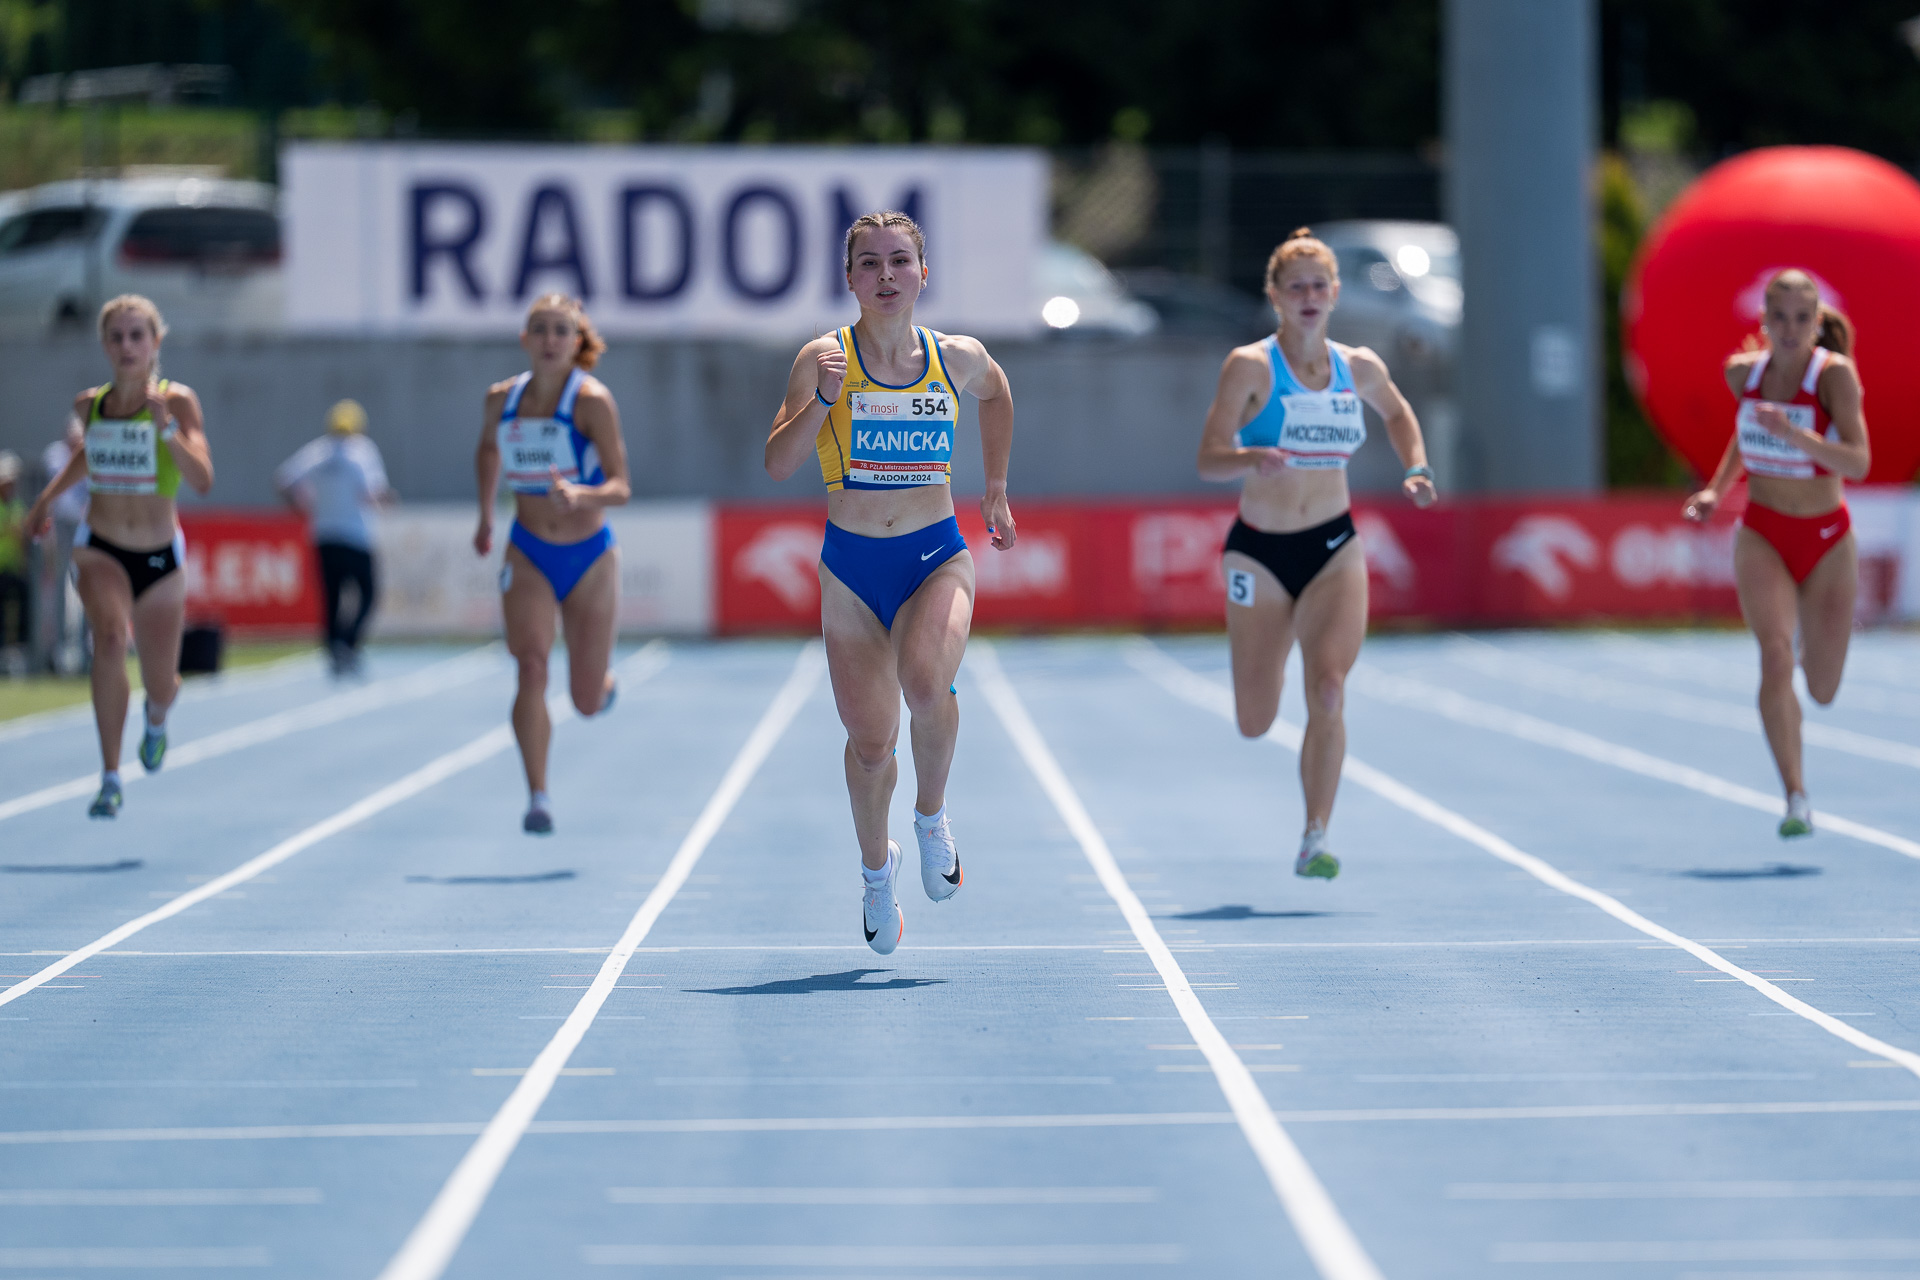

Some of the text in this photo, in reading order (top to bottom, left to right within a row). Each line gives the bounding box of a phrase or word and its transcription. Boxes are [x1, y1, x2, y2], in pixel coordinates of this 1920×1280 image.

[870, 402, 899, 413] mosir
[912, 398, 948, 415] 554
[856, 430, 950, 451] KANICKA
[873, 474, 931, 482] RADOM 2024
[1233, 573, 1247, 601] 5
